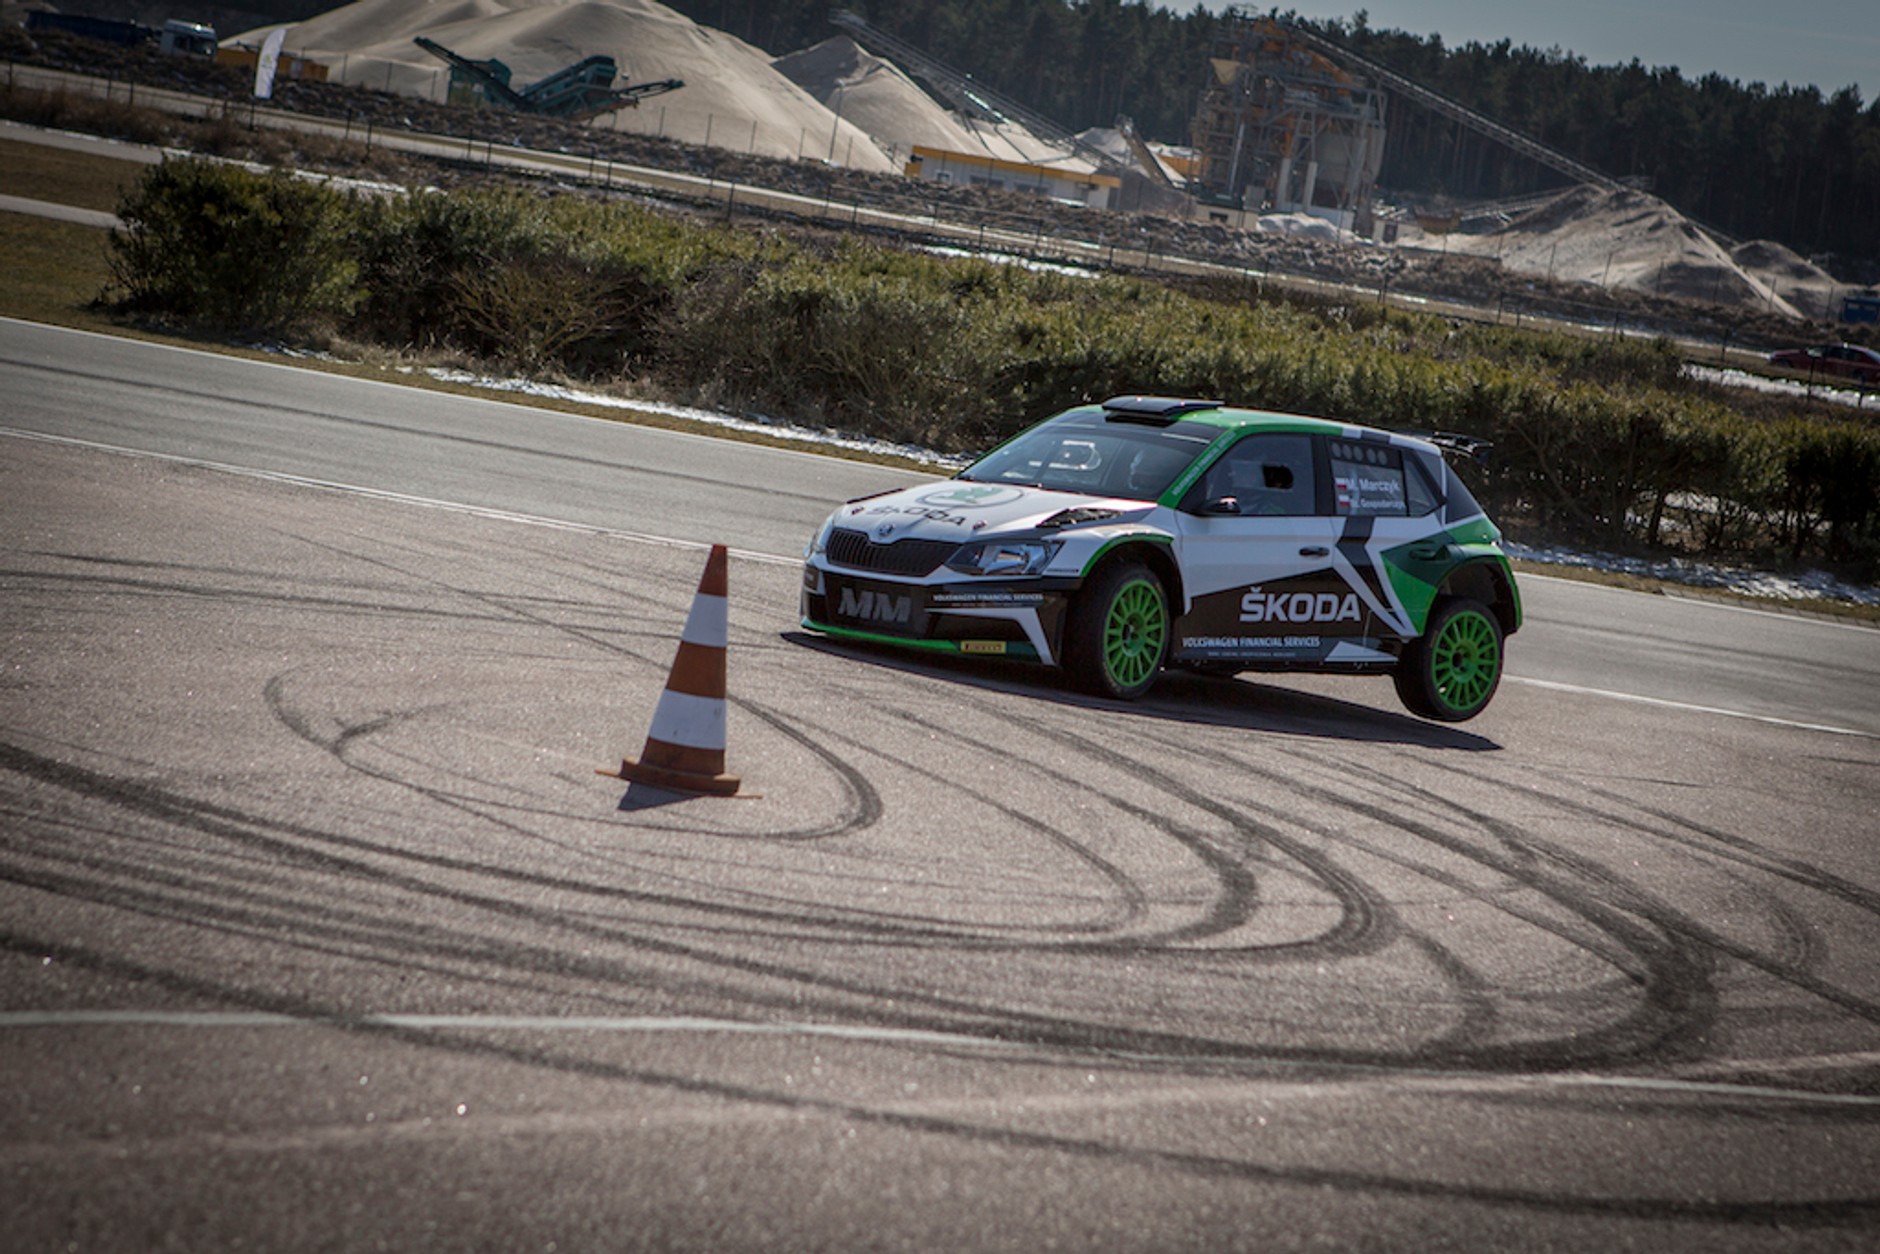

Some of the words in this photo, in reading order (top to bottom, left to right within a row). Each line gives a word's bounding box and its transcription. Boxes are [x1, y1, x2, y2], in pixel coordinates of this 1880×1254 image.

[837, 586, 912, 623] MM
[932, 593, 977, 602] VOLKSWAGEN
[977, 593, 1012, 602] FINANCIAL
[1012, 593, 1044, 601] SERVICES
[1239, 586, 1361, 622] ŠKODA
[1182, 636, 1239, 648] VOLKSWAGEN
[1240, 636, 1282, 648] FINANCIAL
[1283, 635, 1320, 648] SERVICES
